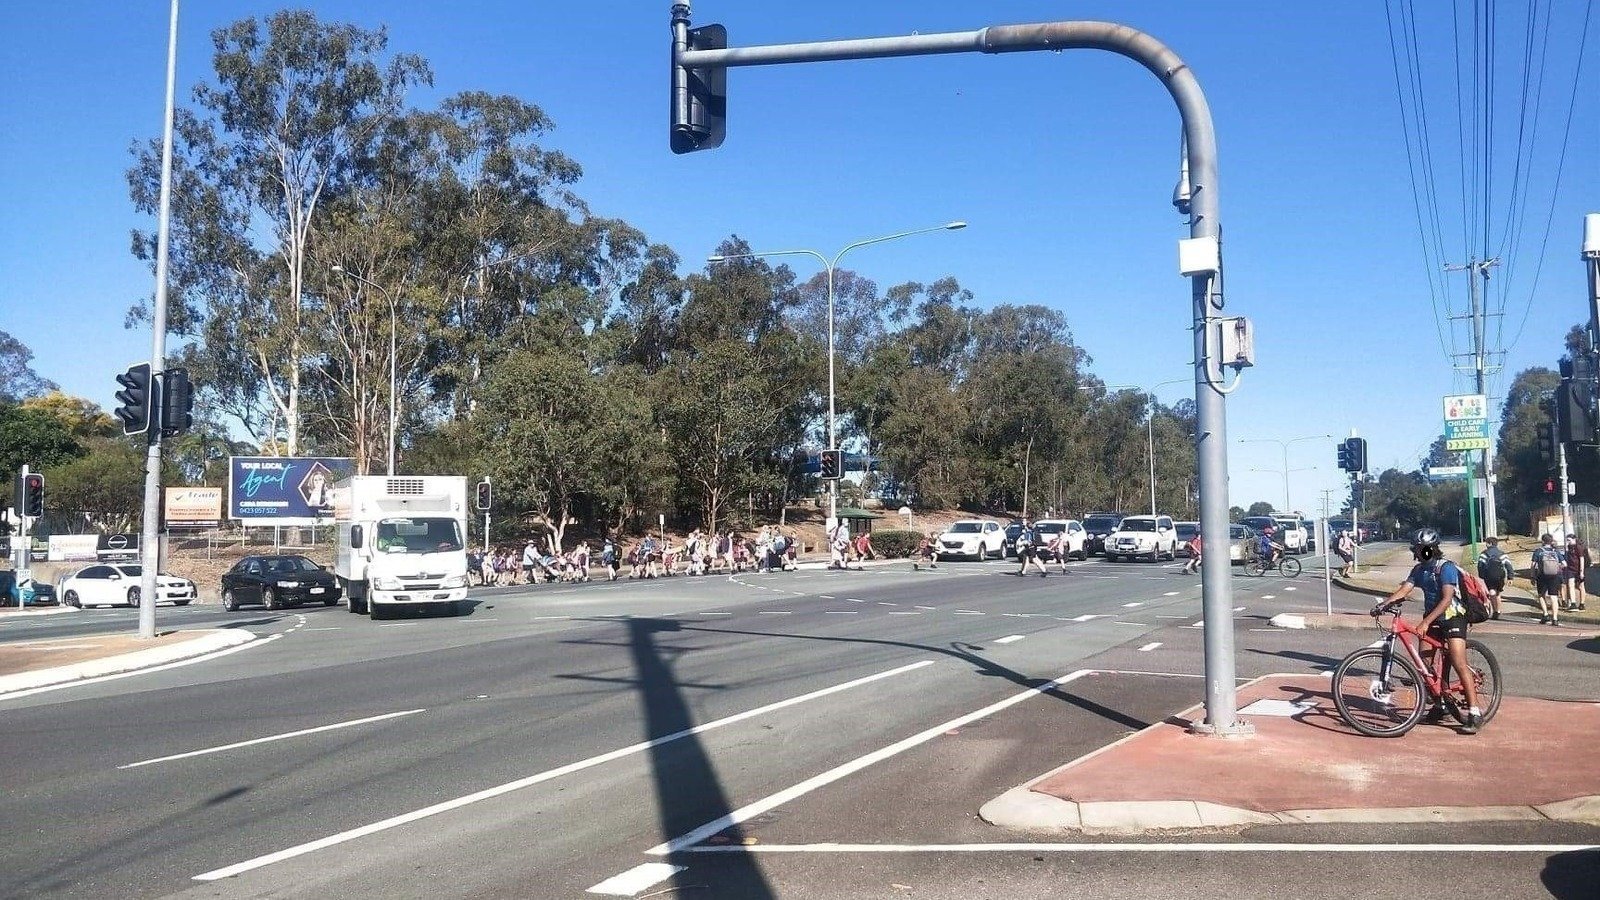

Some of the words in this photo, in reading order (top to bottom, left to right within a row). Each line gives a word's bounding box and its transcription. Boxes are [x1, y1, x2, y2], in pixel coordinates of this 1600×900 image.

[240, 462, 260, 470] YOUR
[261, 462, 283, 470] LOCAL
[239, 464, 296, 498] Agent
